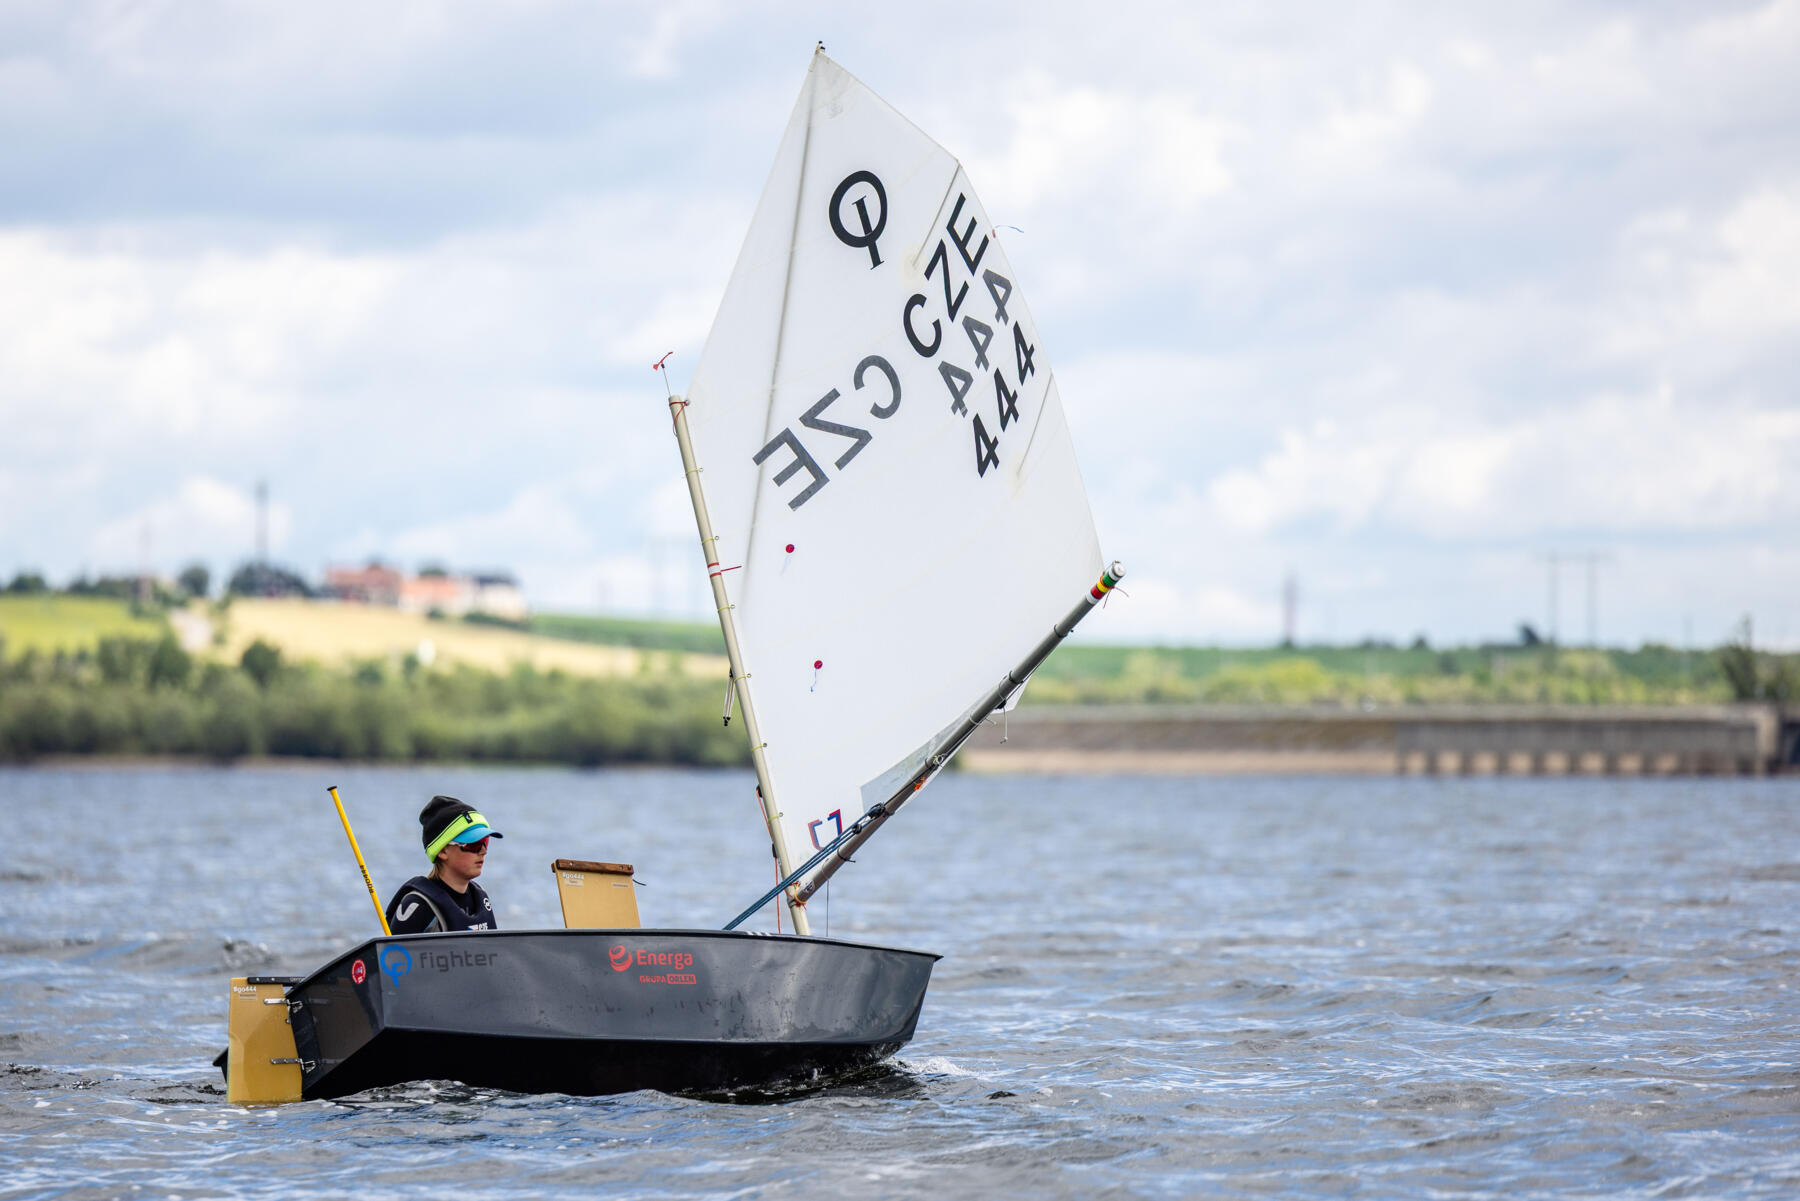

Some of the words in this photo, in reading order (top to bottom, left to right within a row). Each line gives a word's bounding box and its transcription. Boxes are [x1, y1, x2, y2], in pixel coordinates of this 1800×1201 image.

[903, 192, 990, 358] CZE
[972, 320, 1035, 478] 444
[419, 950, 498, 973] fighter
[636, 949, 694, 971] Energa
[639, 975, 666, 984] GRUPA
[667, 974, 696, 984] ORLEN
